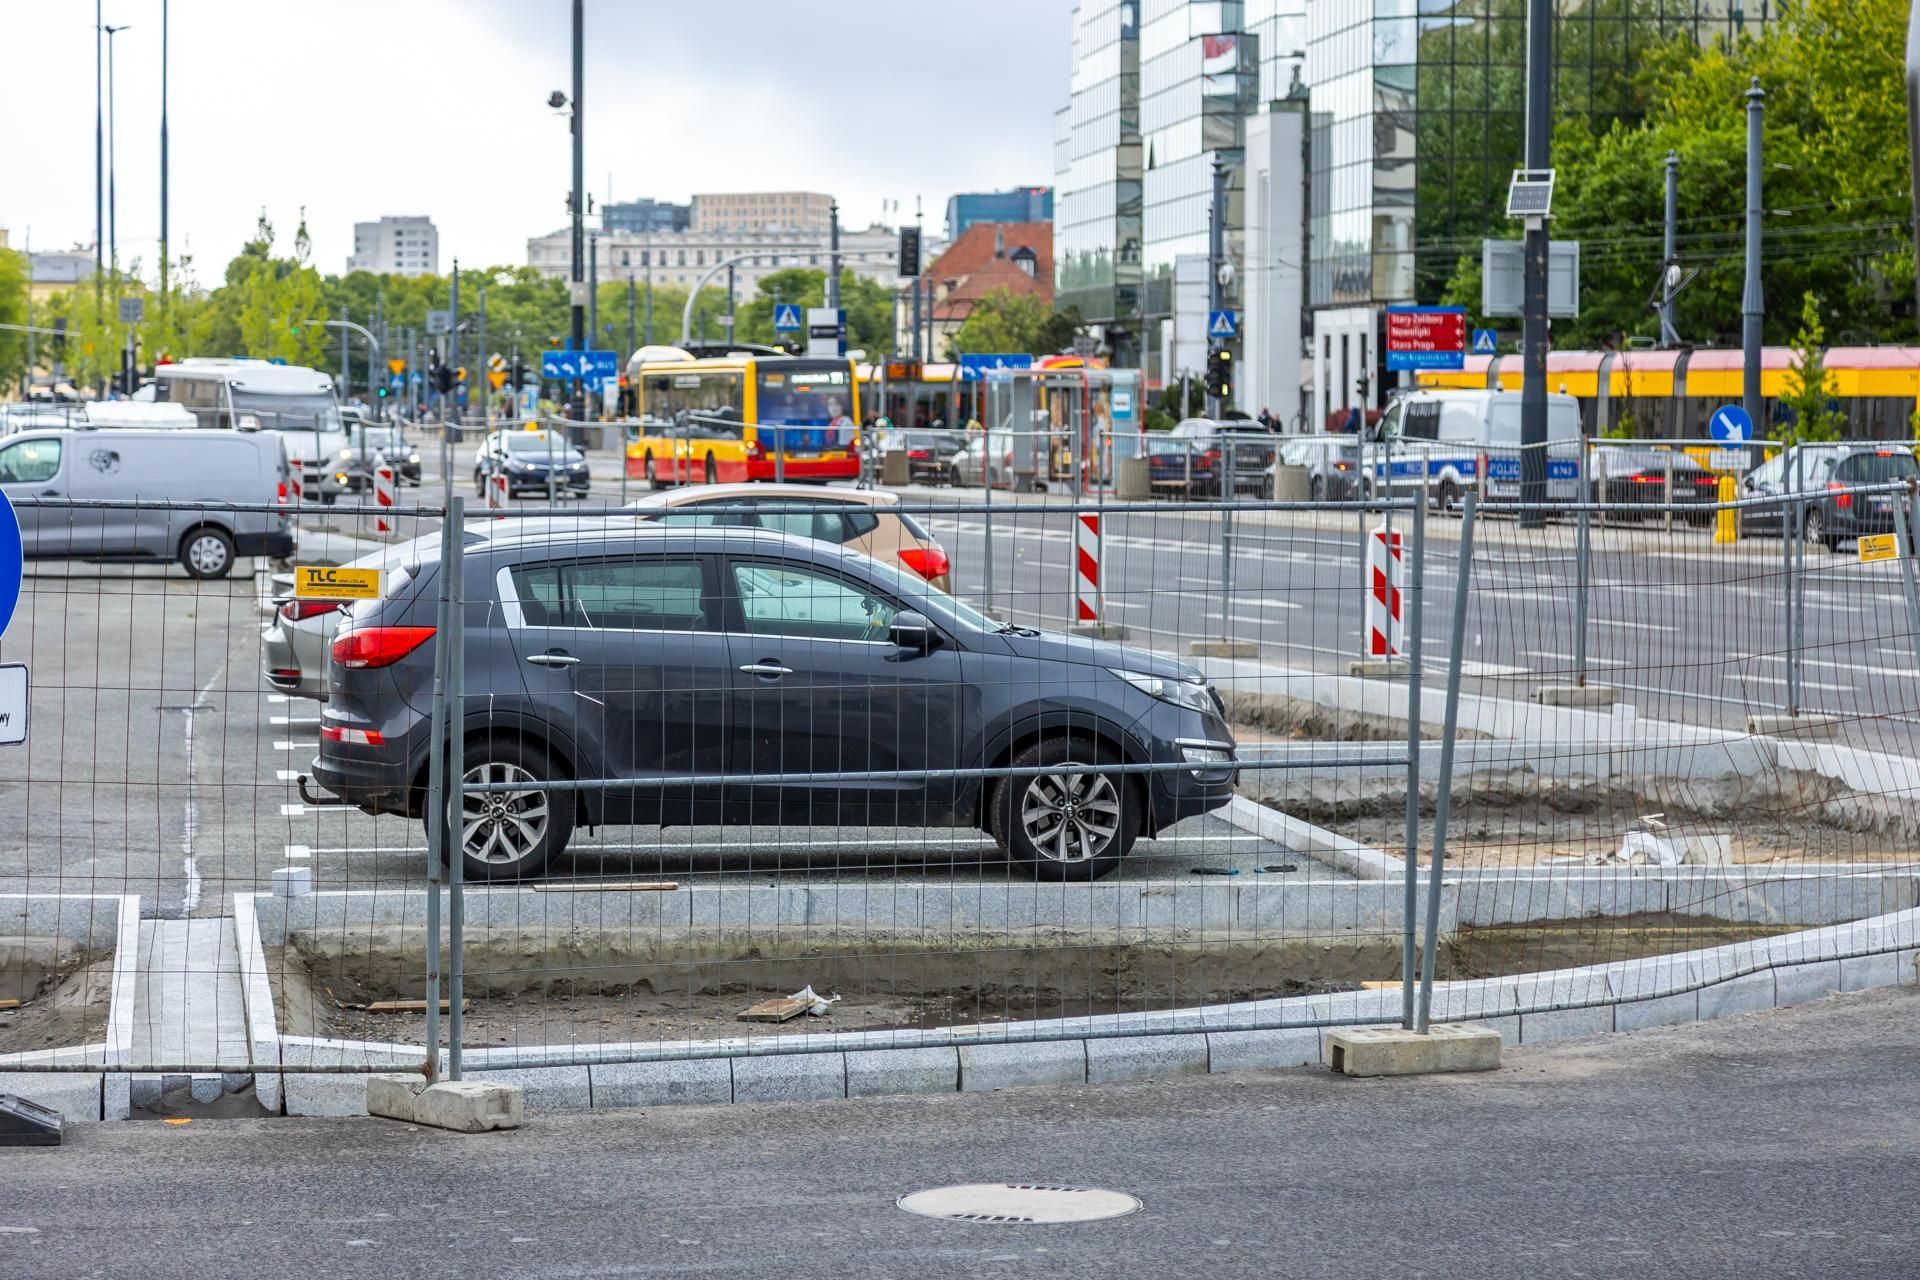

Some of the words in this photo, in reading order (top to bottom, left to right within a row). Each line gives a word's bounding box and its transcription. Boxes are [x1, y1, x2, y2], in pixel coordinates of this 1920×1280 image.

[1391, 313, 1411, 326] Stary
[1391, 327, 1431, 338] Nowolipki
[1391, 340, 1412, 350] Stara
[1413, 339, 1435, 351] Praga
[307, 569, 337, 582] TLC
